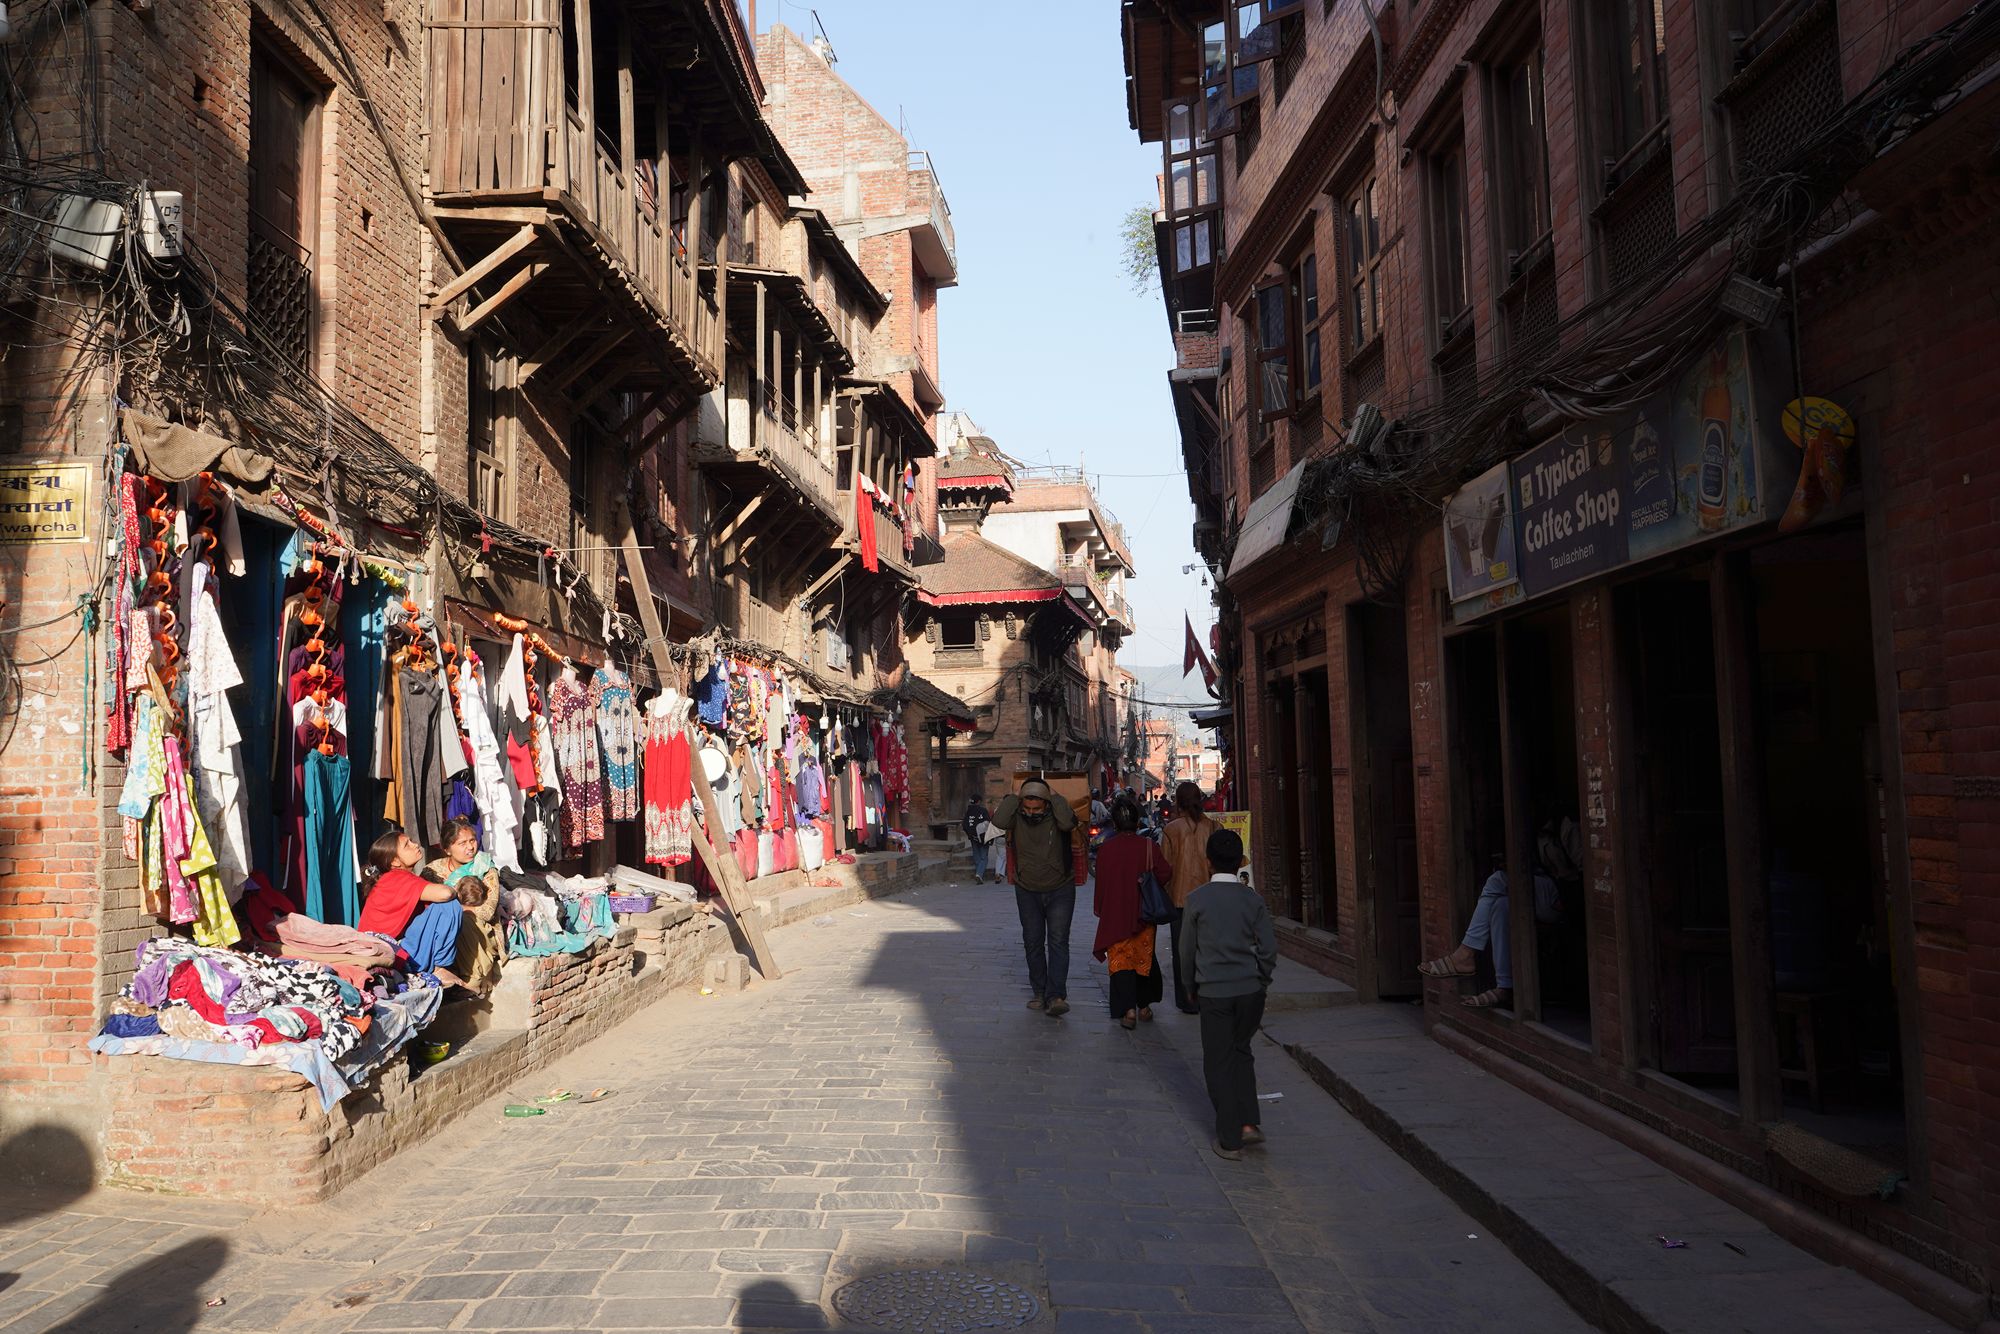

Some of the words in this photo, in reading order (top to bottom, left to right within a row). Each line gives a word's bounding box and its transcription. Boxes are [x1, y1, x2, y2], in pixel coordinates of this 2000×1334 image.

[1535, 434, 1591, 500] Typical
[1525, 508, 1574, 553] Coffee
[1574, 487, 1621, 532] Shop
[1631, 503, 1652, 520] RECALL
[1651, 498, 1669, 513] YOUR
[1631, 509, 1670, 531] HAPPINESS
[1550, 543, 1595, 571] Taulachhen
